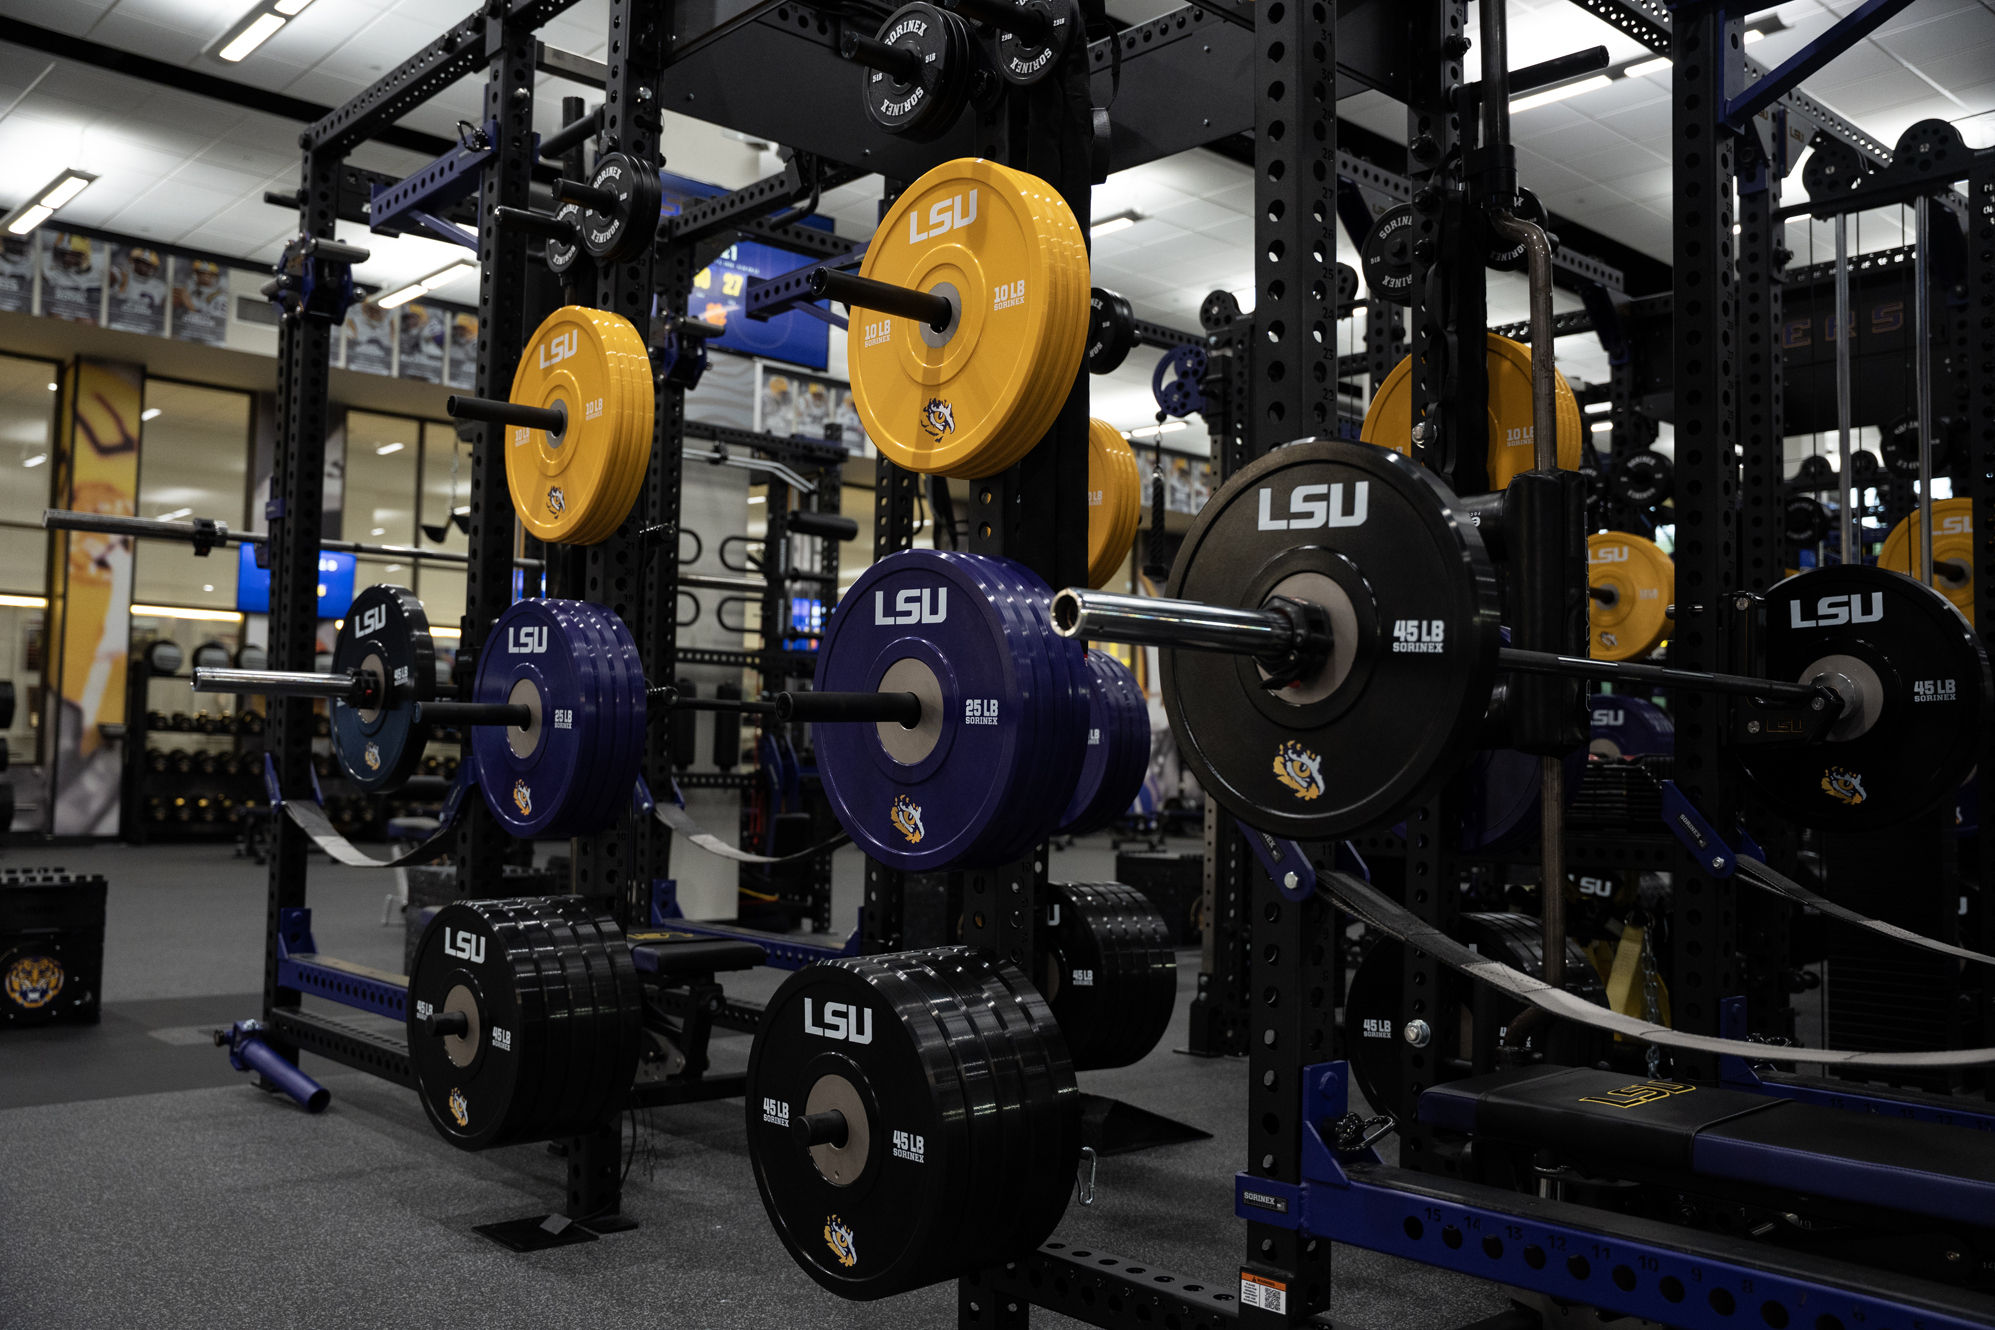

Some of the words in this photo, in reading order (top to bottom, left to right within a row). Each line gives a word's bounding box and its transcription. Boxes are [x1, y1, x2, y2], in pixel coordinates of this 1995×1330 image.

[1322, 30, 1334, 43] 31
[1010, 47, 1053, 74] SORINEX
[1322, 69, 1334, 83] 30
[880, 86, 924, 117] SORINEX
[1322, 108, 1334, 122] 29
[1322, 148, 1334, 161] 28
[593, 167, 622, 188] SORINEX
[1322, 188, 1334, 200] 27
[909, 189, 978, 245] LSU
[591, 220, 619, 243] SORINEX
[1322, 228, 1334, 240] 26
[1379, 216, 1412, 239] SORINE
[1322, 267, 1334, 280] 25
[994, 284, 1008, 304] 10
[1010, 280, 1025, 299] LB
[994, 296, 1025, 311] SORINEX
[1322, 308, 1334, 320] 24
[864, 324, 876, 341] 10
[878, 319, 890, 336] LB
[864, 334, 890, 348] SORINEX
[540, 329, 578, 370] LSU
[1322, 348, 1334, 360] 23
[1322, 389, 1334, 401] 22
[586, 401, 594, 415] 10
[594, 398, 603, 411] LB
[515, 428, 522, 441] 10
[523, 427, 530, 440] LB
[1507, 429, 1522, 441] 10
[1257, 481, 1369, 531] LSU
[1588, 546, 1629, 564] LSU
[874, 587, 947, 626] LSU
[1790, 591, 1884, 629] LSU
[354, 603, 386, 639] LSU
[1393, 620, 1421, 642] 45
[1422, 619, 1445, 642] LB
[508, 626, 548, 654] LSU
[1392, 642, 1444, 653] SORINEX
[394, 666, 401, 680] 45
[401, 665, 408, 678] LB
[1913, 679, 1935, 696] 45
[1936, 678, 1956, 694] LB
[1914, 692, 1956, 702] SORINEX
[965, 699, 982, 716] 25
[983, 699, 998, 716] LB
[554, 709, 564, 722] 25
[564, 709, 573, 722] LB
[965, 716, 998, 725] SORINEX
[1766, 720, 1803, 733] LSU
[1680, 813, 1702, 839] SORINEX
[1322, 844, 1332, 856] 11
[1022, 862, 1031, 872] 10
[1323, 929, 1329, 940] 9
[444, 926, 486, 964] LSU
[1072, 969, 1082, 980] 45
[1083, 969, 1093, 980] LB
[416, 999, 425, 1014] 45
[425, 1003, 433, 1015] LB
[804, 997, 873, 1045] LSU
[1363, 1018, 1378, 1032] 45
[1378, 1019, 1392, 1032] LB
[492, 1025, 502, 1041] 45
[502, 1029, 511, 1044] LB
[1363, 1031, 1392, 1039] SORINEX
[1578, 1080, 1696, 1108] LSU
[763, 1097, 776, 1116] 45
[777, 1100, 790, 1119] LB
[1830, 1098, 1844, 1109] 15
[1864, 1103, 1879, 1115] 14
[1900, 1108, 1914, 1119] 13
[1937, 1114, 1952, 1125] 12
[763, 1114, 789, 1128] SORINEX
[1975, 1120, 1991, 1132] 11
[892, 1129, 908, 1151] 45
[909, 1133, 925, 1155] LB
[892, 1148, 924, 1164] SORINEX
[1243, 1192, 1276, 1205] SORINEX
[1425, 1208, 1441, 1222] 15
[1464, 1216, 1481, 1231] 14
[1505, 1226, 1522, 1240] 13
[1547, 1235, 1566, 1251] 12
[1592, 1245, 1610, 1260] 11
[1638, 1256, 1658, 1272] 10
[1691, 1268, 1702, 1282] 9
[1742, 1279, 1753, 1294] 8
[1213, 1315, 1226, 1329] 24
